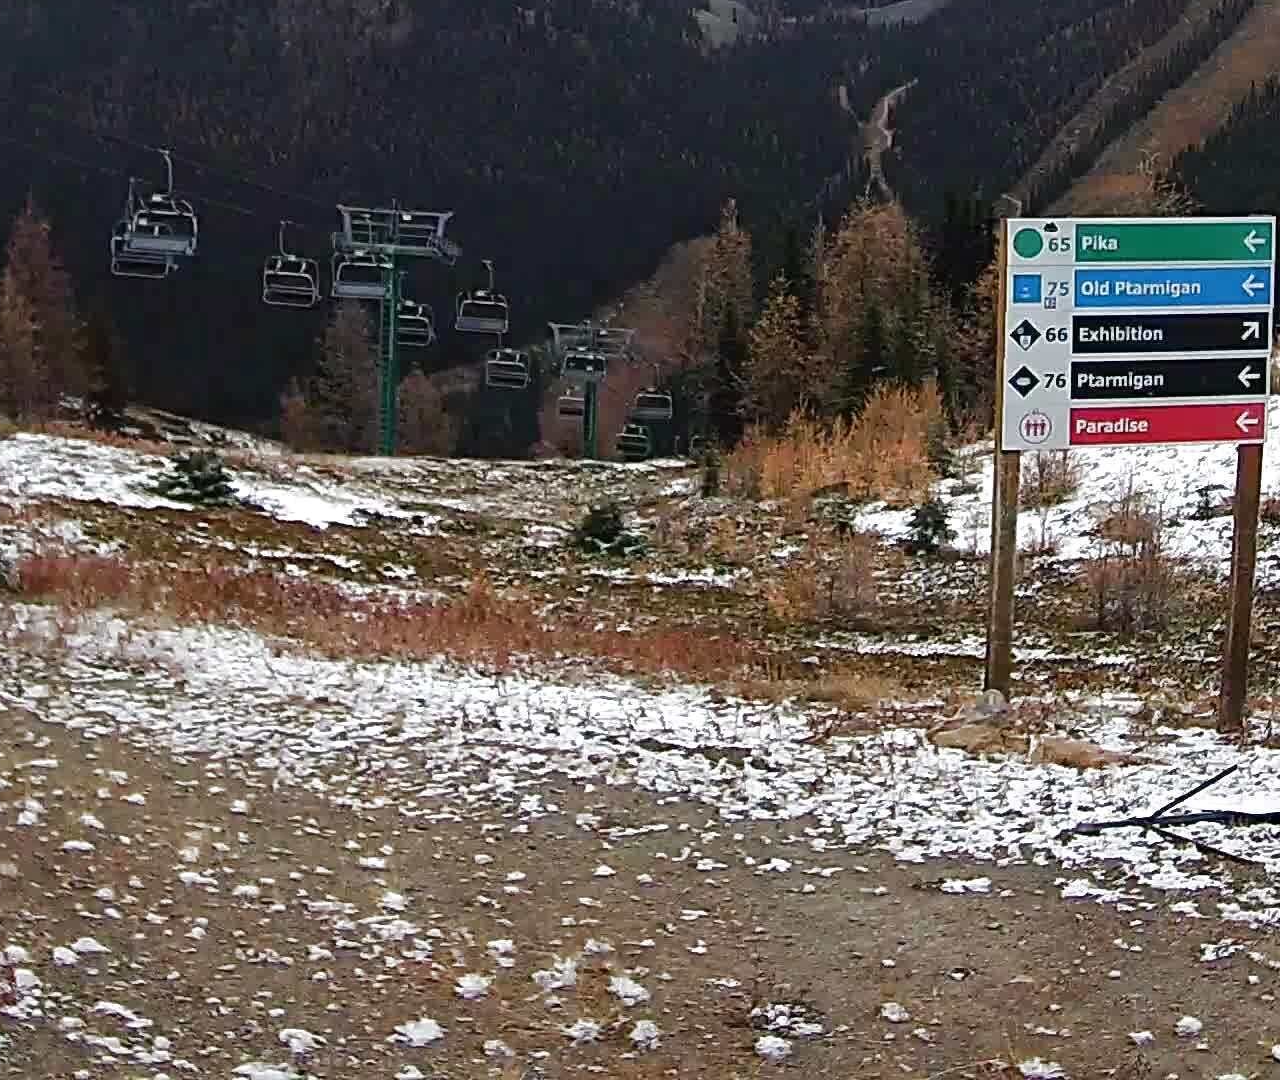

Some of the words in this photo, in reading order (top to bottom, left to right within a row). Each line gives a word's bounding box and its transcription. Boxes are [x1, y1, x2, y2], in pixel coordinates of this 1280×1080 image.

[1048, 237, 1071, 252] 65
[1081, 235, 1118, 251] Pika
[1047, 281, 1070, 297] 75
[1080, 280, 1109, 296] Old
[1115, 281, 1201, 298] Ptarmigan
[1045, 326, 1068, 343] 66
[1079, 325, 1163, 342] Exhibition
[1043, 373, 1067, 389] 76
[1077, 371, 1164, 390] Ptarmigan
[1075, 418, 1148, 434] Paradise
